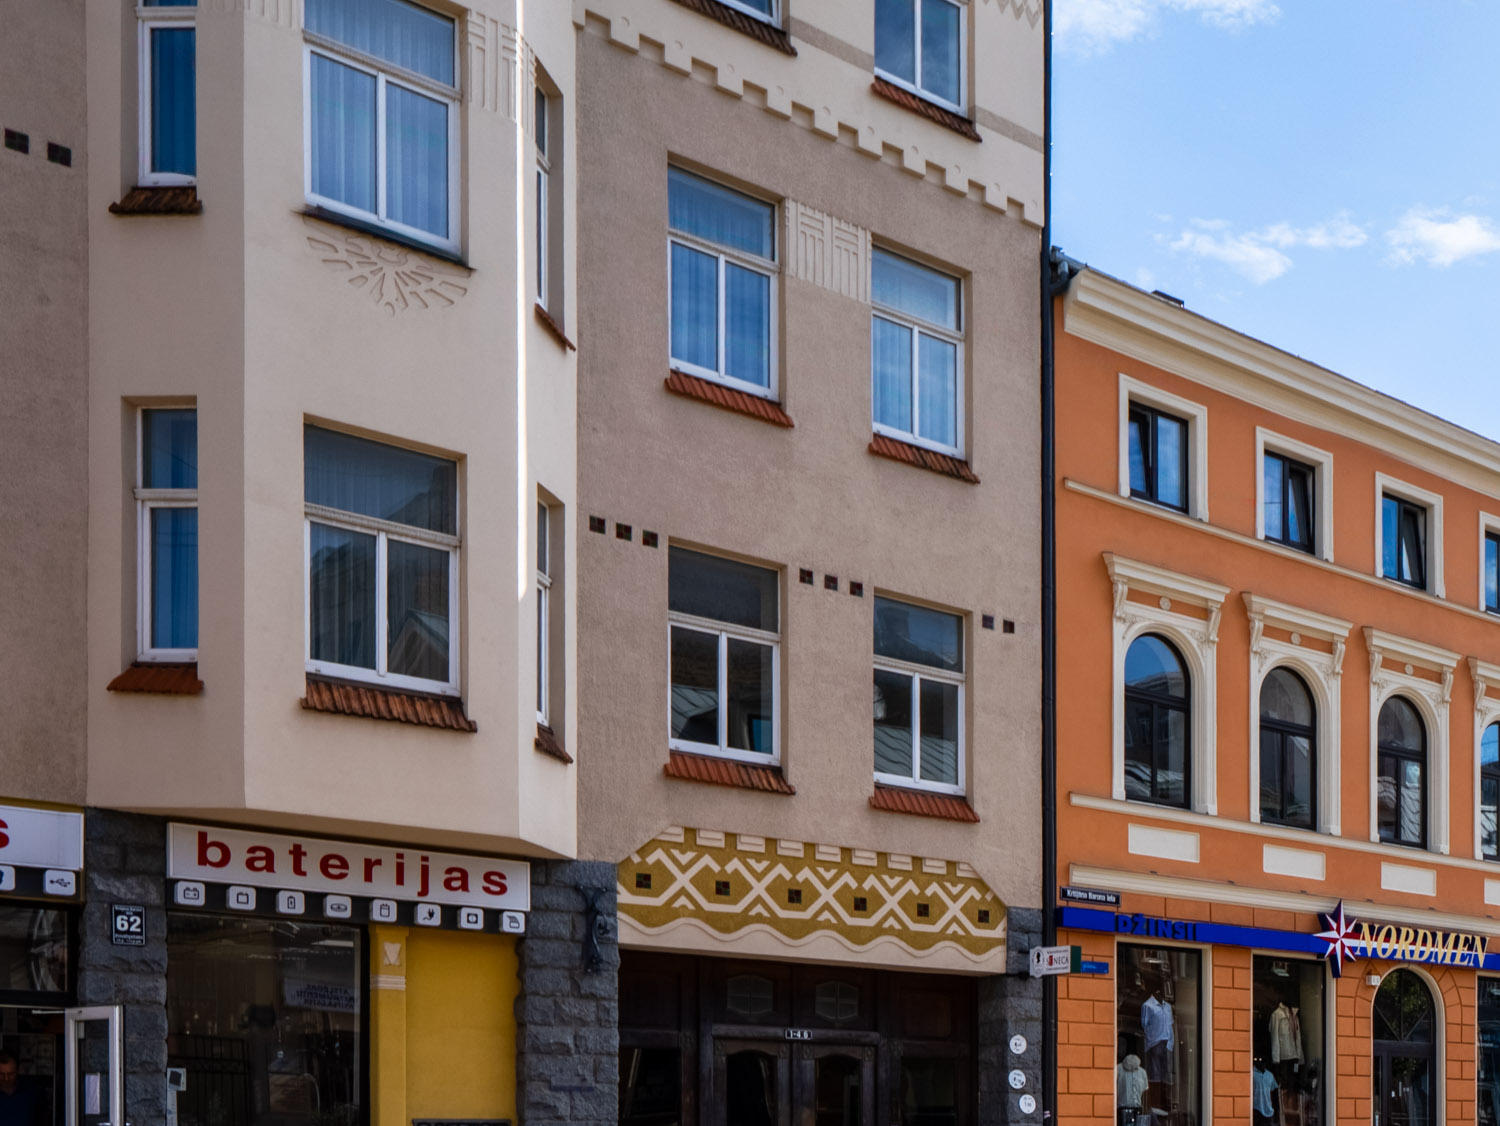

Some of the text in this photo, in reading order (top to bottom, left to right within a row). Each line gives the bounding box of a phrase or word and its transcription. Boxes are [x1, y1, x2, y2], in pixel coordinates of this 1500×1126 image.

[197, 831, 509, 898] baterijas
[116, 915, 142, 932] 62
[1116, 913, 1195, 941] DŽINSI
[1355, 921, 1491, 969] NORDMEN
